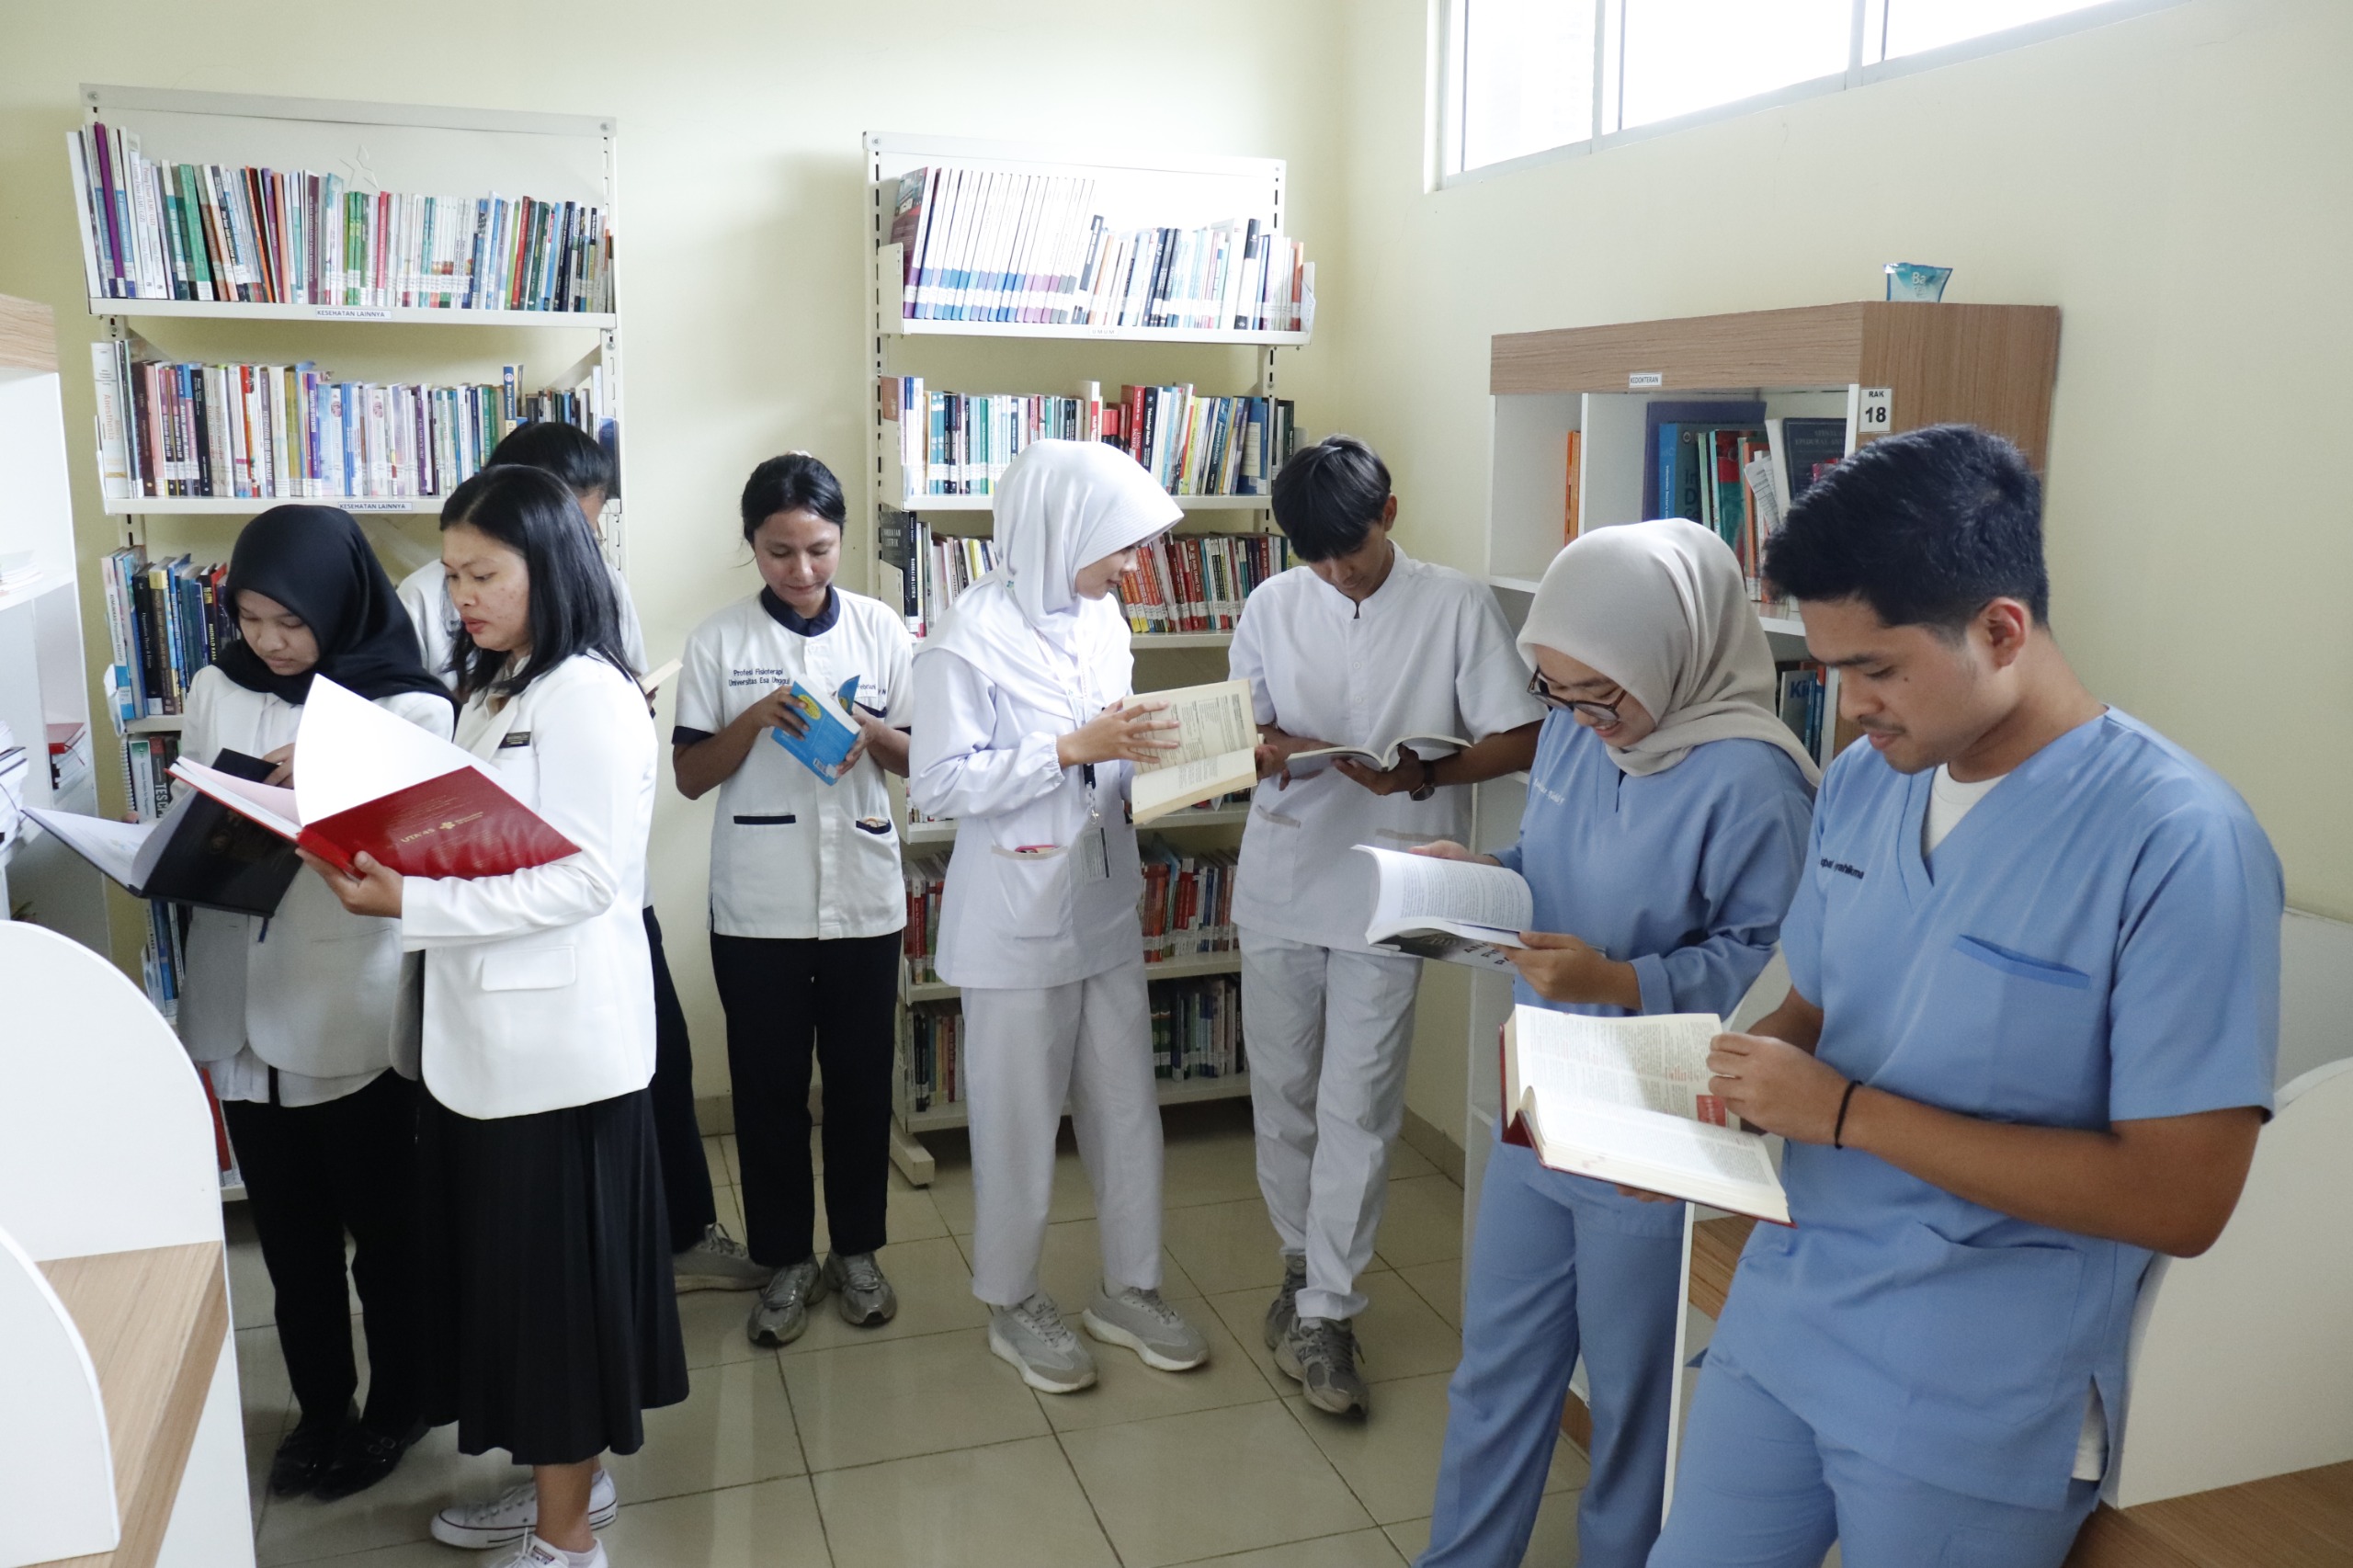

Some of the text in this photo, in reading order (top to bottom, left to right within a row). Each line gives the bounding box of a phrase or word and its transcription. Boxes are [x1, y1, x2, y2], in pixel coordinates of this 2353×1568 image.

[103, 394, 114, 440] Anesthesia
[1865, 407, 1886, 423] 18
[729, 678, 757, 687] Universitas
[772, 677, 790, 686] Unggul
[155, 783, 167, 801] TES
